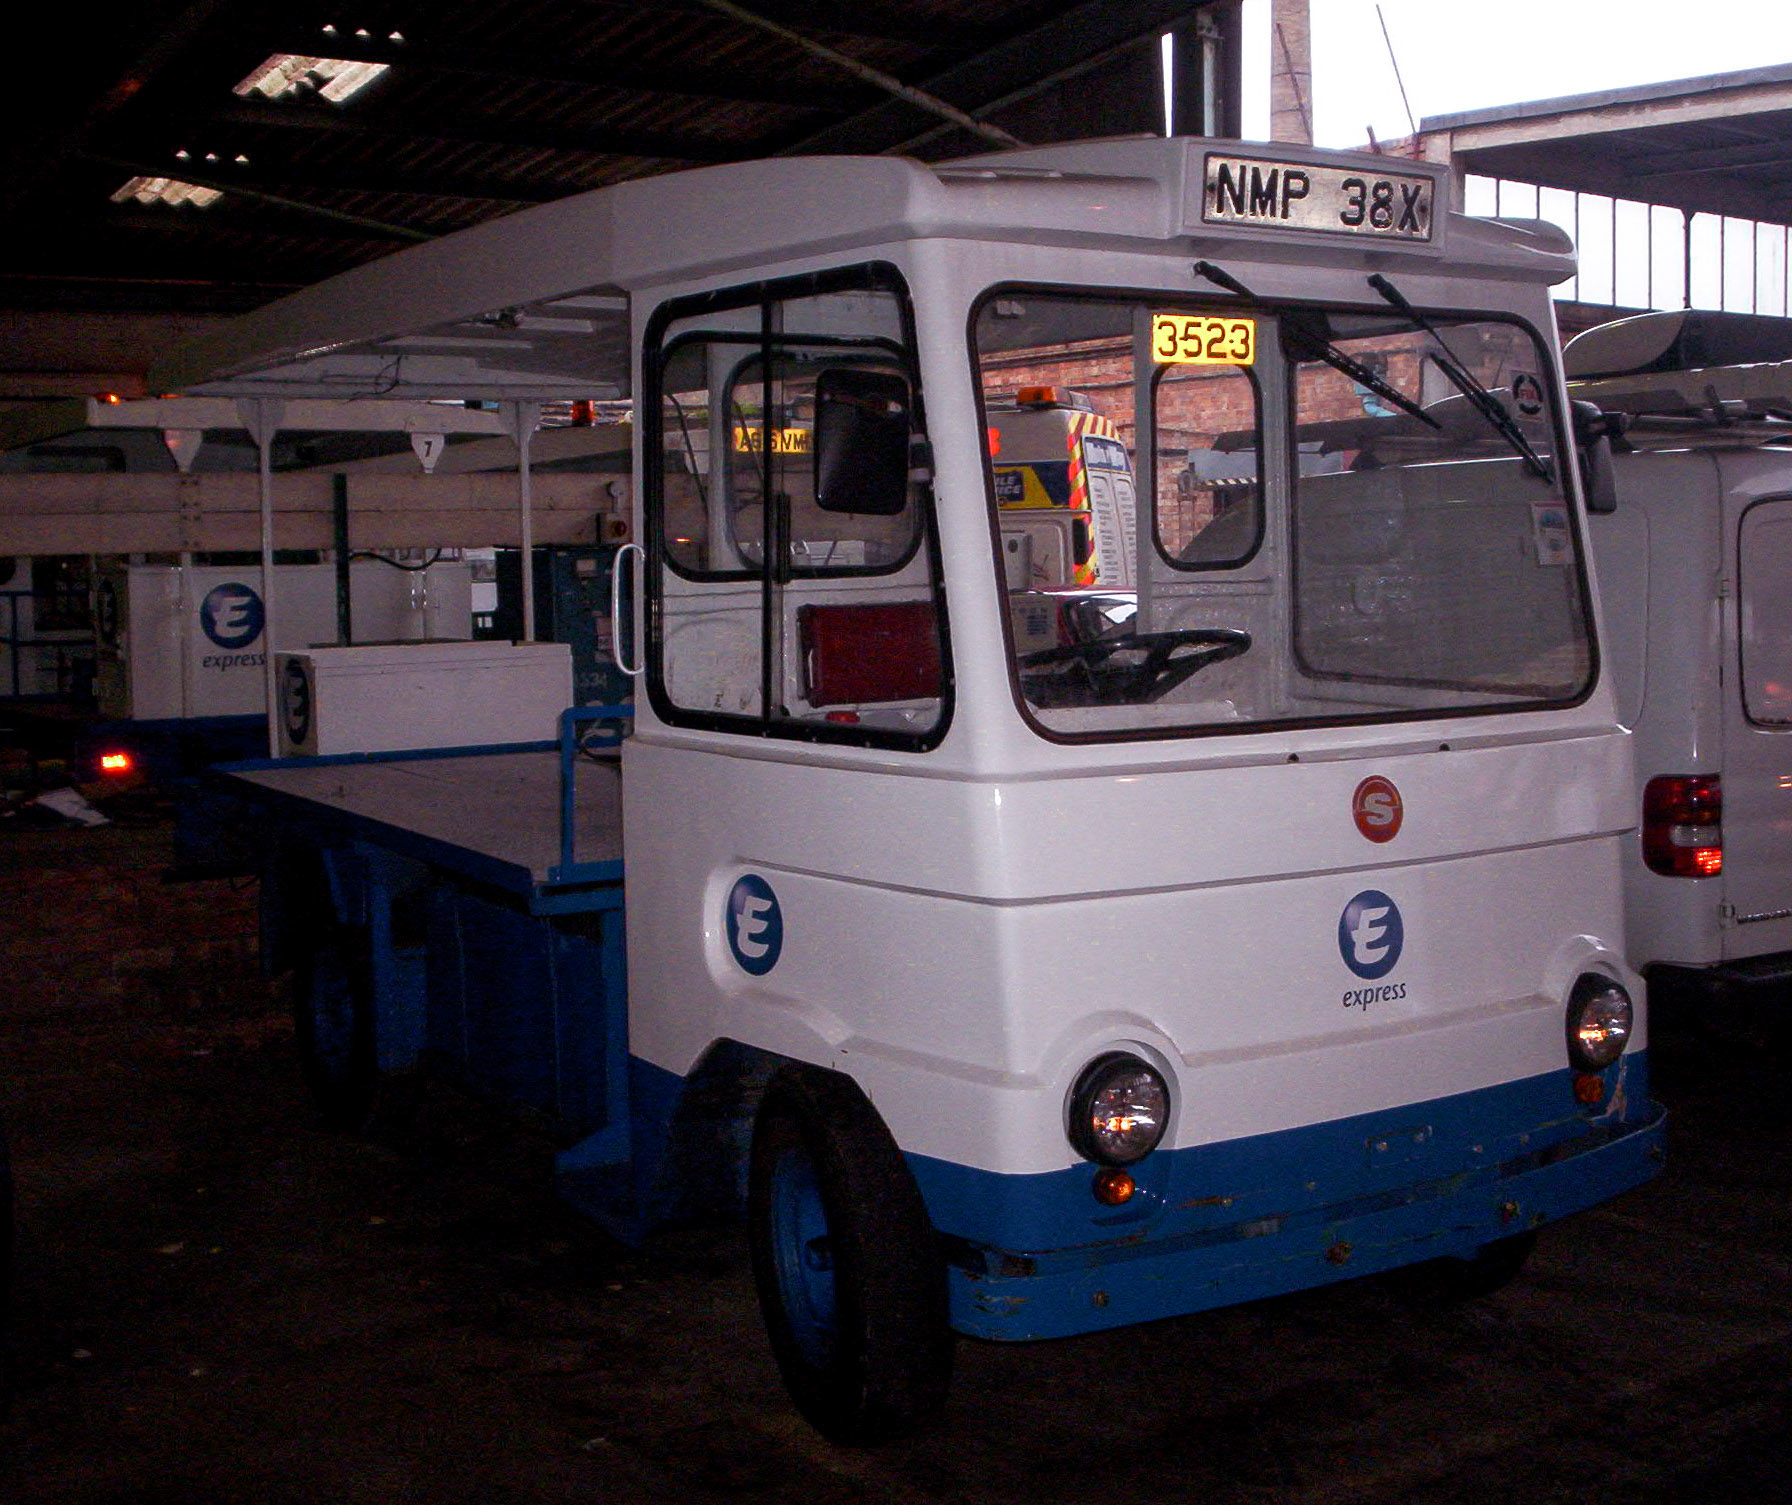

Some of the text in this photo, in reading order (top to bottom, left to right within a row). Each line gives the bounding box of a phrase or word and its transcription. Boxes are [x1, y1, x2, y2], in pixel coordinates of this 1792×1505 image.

[1216, 163, 1422, 232] NMP 38X
[1157, 320, 1250, 360] 3523
[424, 440, 433, 458] 7
[203, 651, 267, 672] express
[1342, 982, 1407, 1011] express
